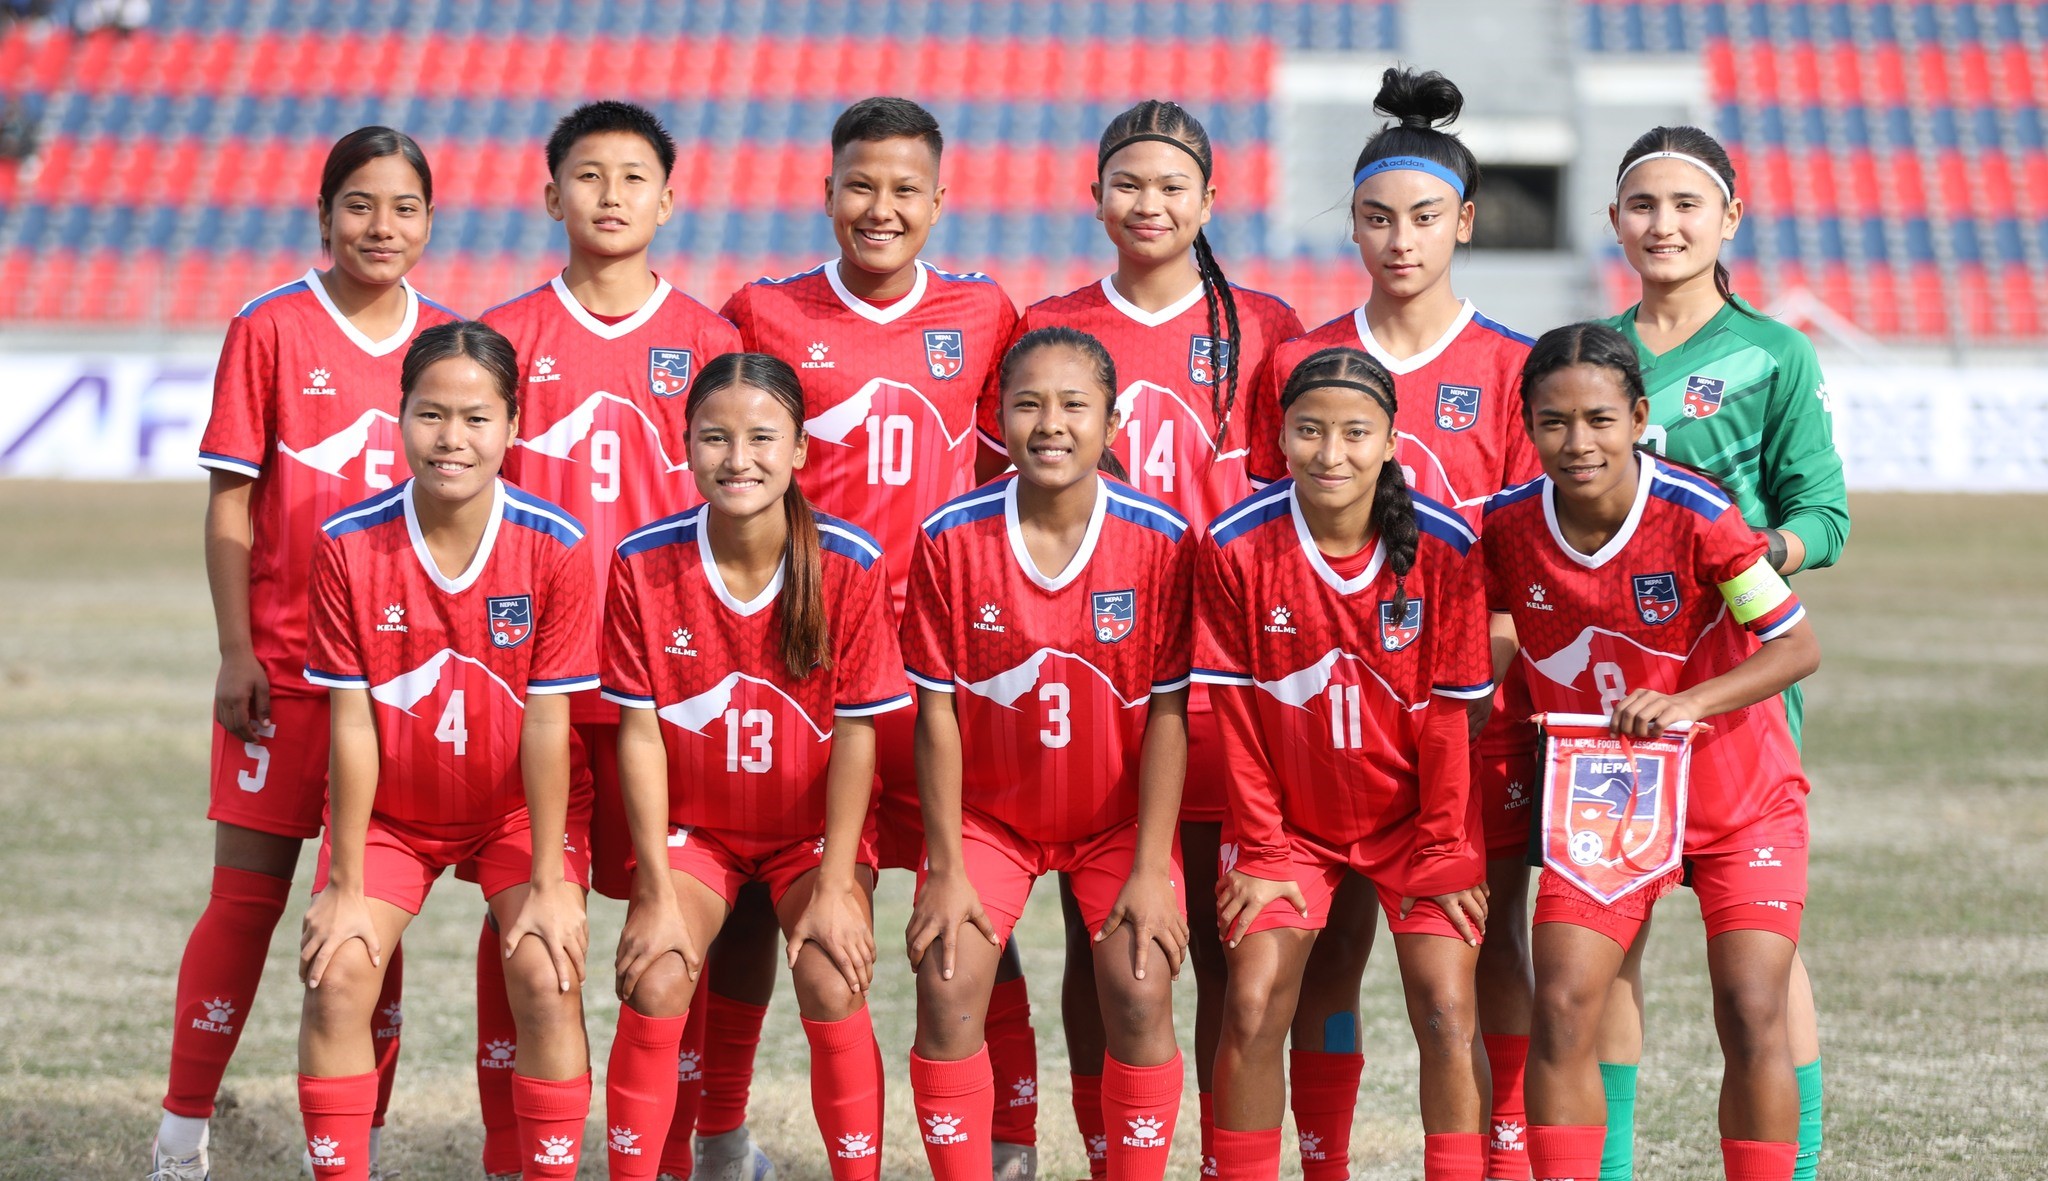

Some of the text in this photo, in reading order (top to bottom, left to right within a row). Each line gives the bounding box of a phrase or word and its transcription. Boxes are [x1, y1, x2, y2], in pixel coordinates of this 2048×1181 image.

[1390, 159, 1425, 169] adidas
[934, 334, 954, 342] NEPAL
[801, 361, 835, 369] KELME
[529, 374, 561, 383] KELME
[1696, 378, 1716, 386] NEPAL
[302, 387, 336, 396] KELME
[1449, 389, 1470, 397] NEPAL
[865, 414, 914, 486] 10
[1127, 420, 1176, 493] 14
[364, 449, 395, 491] 5
[591, 430, 620, 503] 9
[1103, 596, 1124, 604] NEPAL
[1525, 601, 1554, 611] KELME
[376, 624, 409, 633] KELME
[973, 622, 1005, 633] KELME
[1264, 625, 1297, 635] KELME
[664, 646, 698, 657] KELME
[1592, 661, 1629, 718] 8
[1038, 682, 1072, 749] 3
[1328, 684, 1363, 749] 11
[434, 690, 468, 755] 4
[725, 708, 774, 773] 13
[1560, 738, 1574, 747] ALL
[1574, 739, 1597, 748] NEPAL
[1598, 740, 1622, 750] FOOTB
[1504, 797, 1531, 810] KELME
[1749, 860, 1783, 868] KELME
[193, 1018, 233, 1035] KELME
[377, 1028, 401, 1038] KEL
[482, 1059, 515, 1069] KELM
[1010, 1096, 1038, 1107] KELM
[926, 1133, 969, 1146] KELME
[1123, 1136, 1166, 1148] KELME
[1491, 1141, 1525, 1151] KELME
[838, 1146, 877, 1159] KELME
[535, 1154, 574, 1166] KELME
